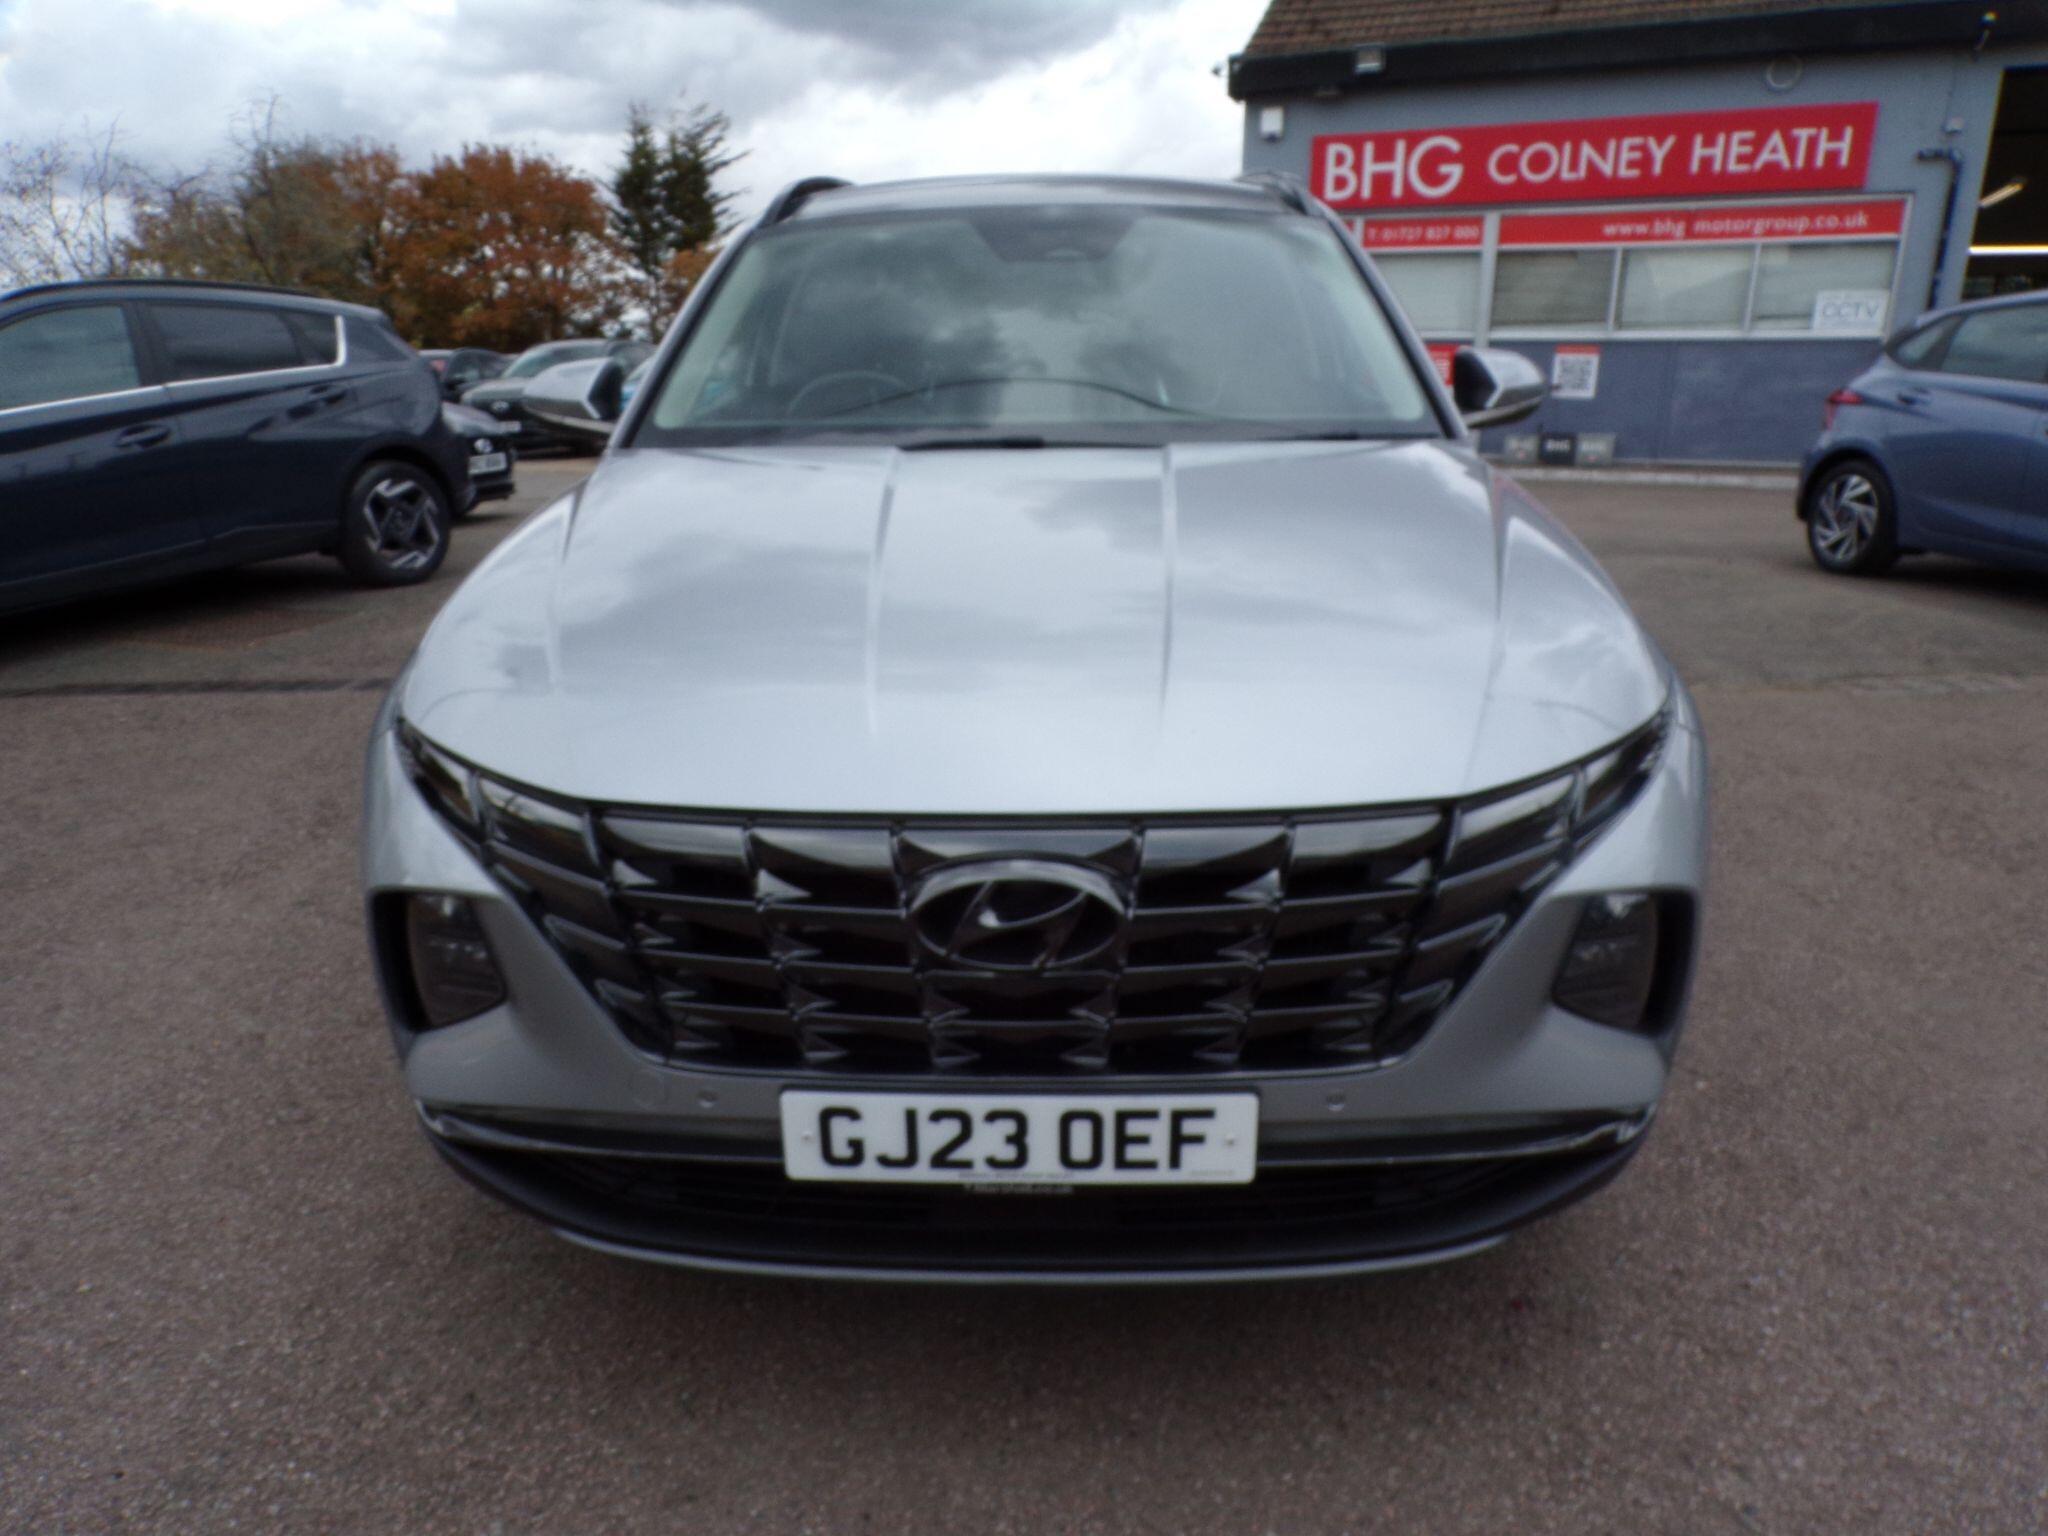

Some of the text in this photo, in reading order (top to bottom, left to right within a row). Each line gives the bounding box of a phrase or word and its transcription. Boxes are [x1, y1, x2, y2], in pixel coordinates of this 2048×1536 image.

[1324, 125, 1853, 200] BHG COLNEY HEATH
[1822, 301, 1880, 319] CCTV
[818, 1106, 1029, 1170] GJ23
